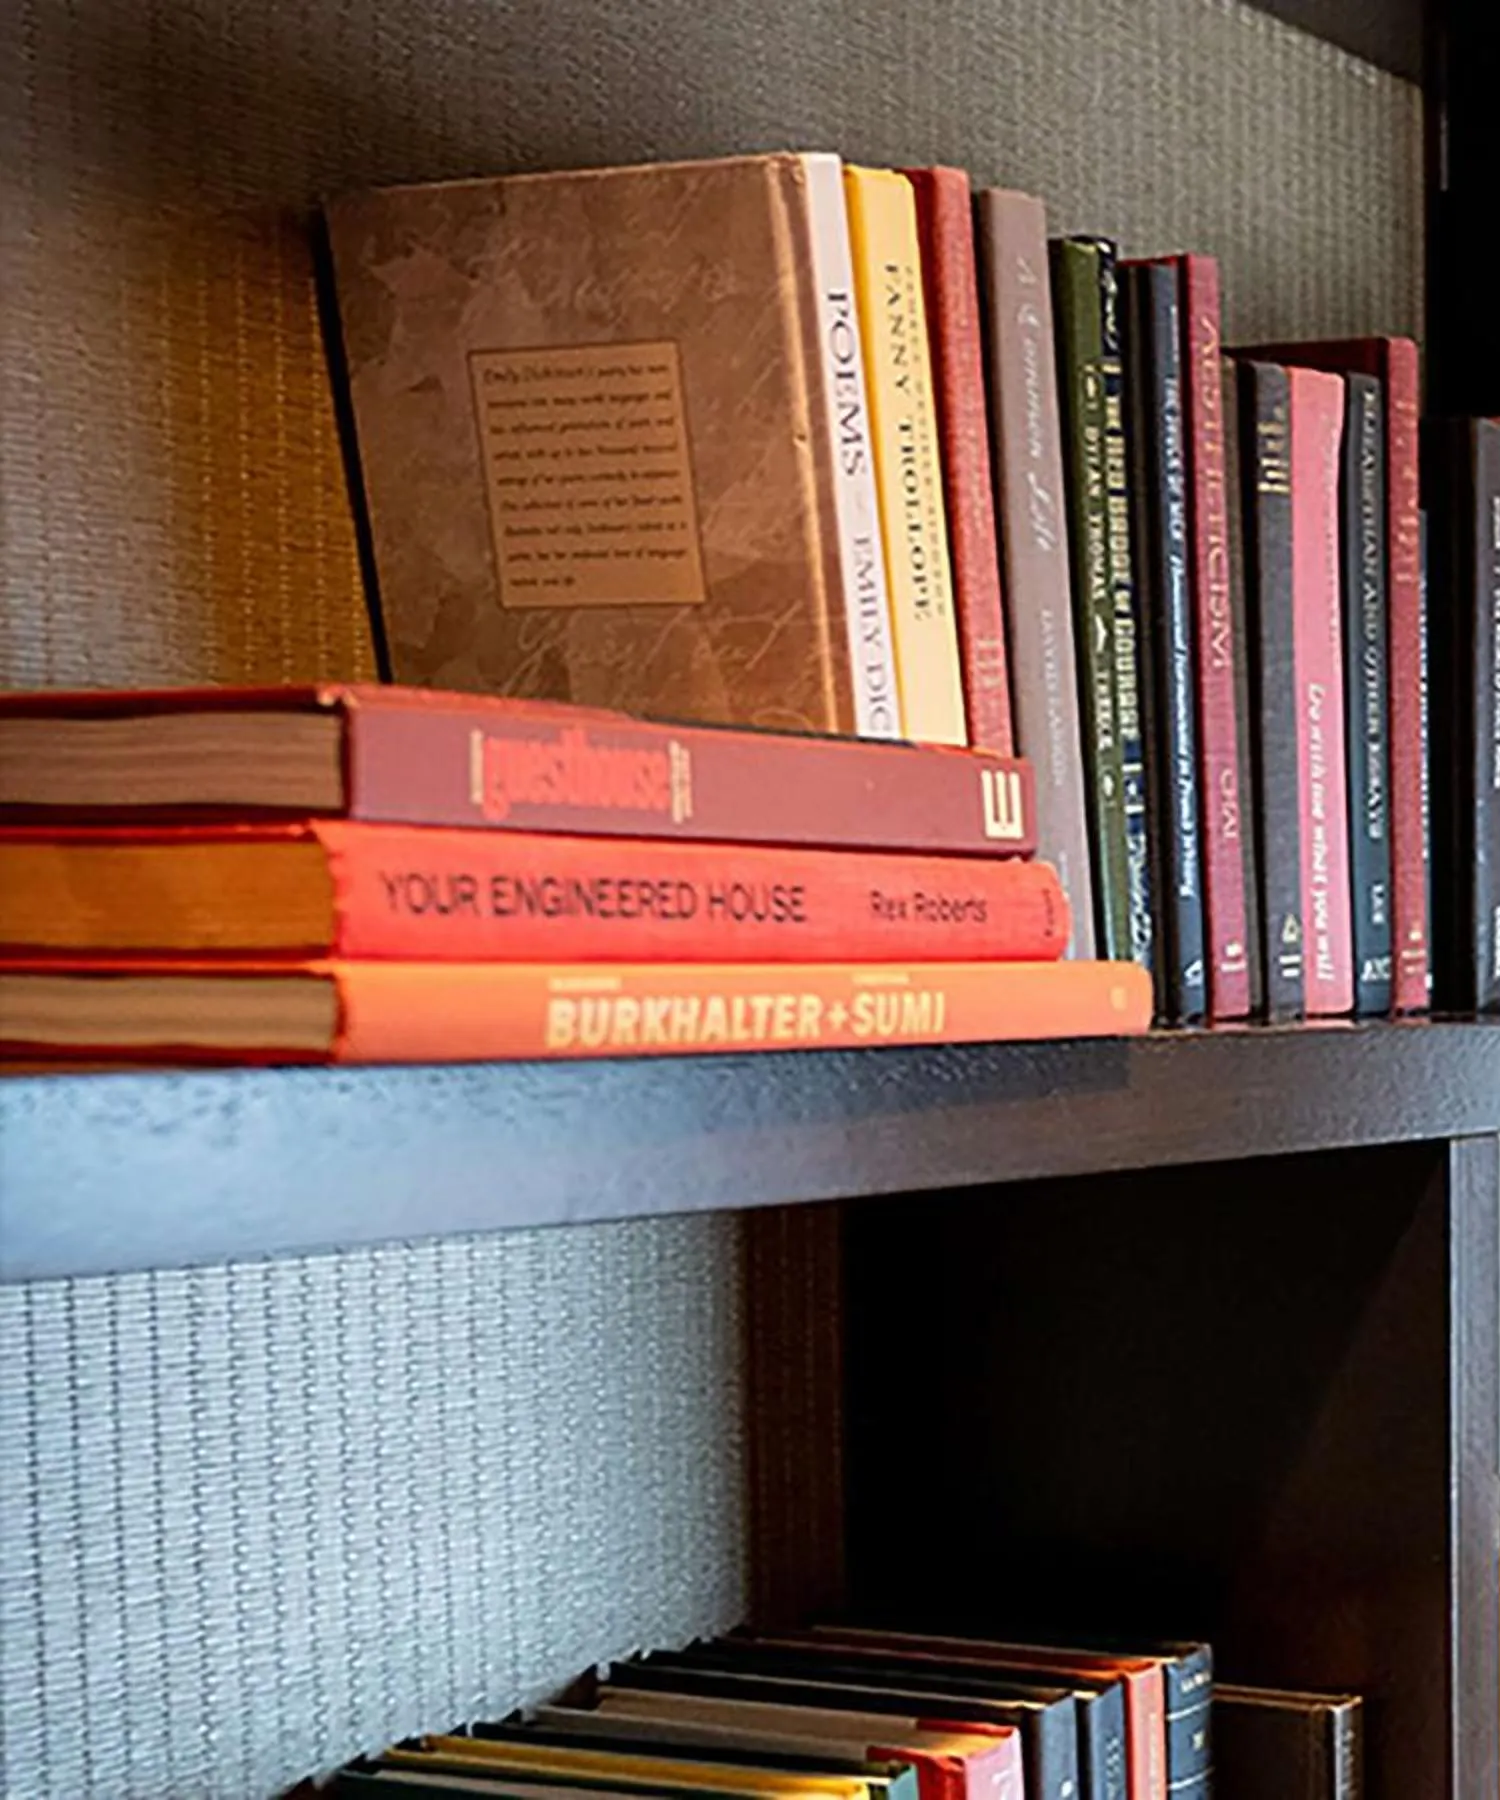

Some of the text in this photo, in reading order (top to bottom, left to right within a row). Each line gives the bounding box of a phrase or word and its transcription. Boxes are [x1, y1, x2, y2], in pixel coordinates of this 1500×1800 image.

[828, 291, 867, 478] POEMS
[852, 536, 886, 652] EMILY
[885, 263, 933, 622] FANNY TROLLOPE
[1219, 767, 1240, 840] CHAI
[378, 872, 807, 923] YOUR ENGINEERED HOUSE
[871, 890, 988, 924] Rex Roberts
